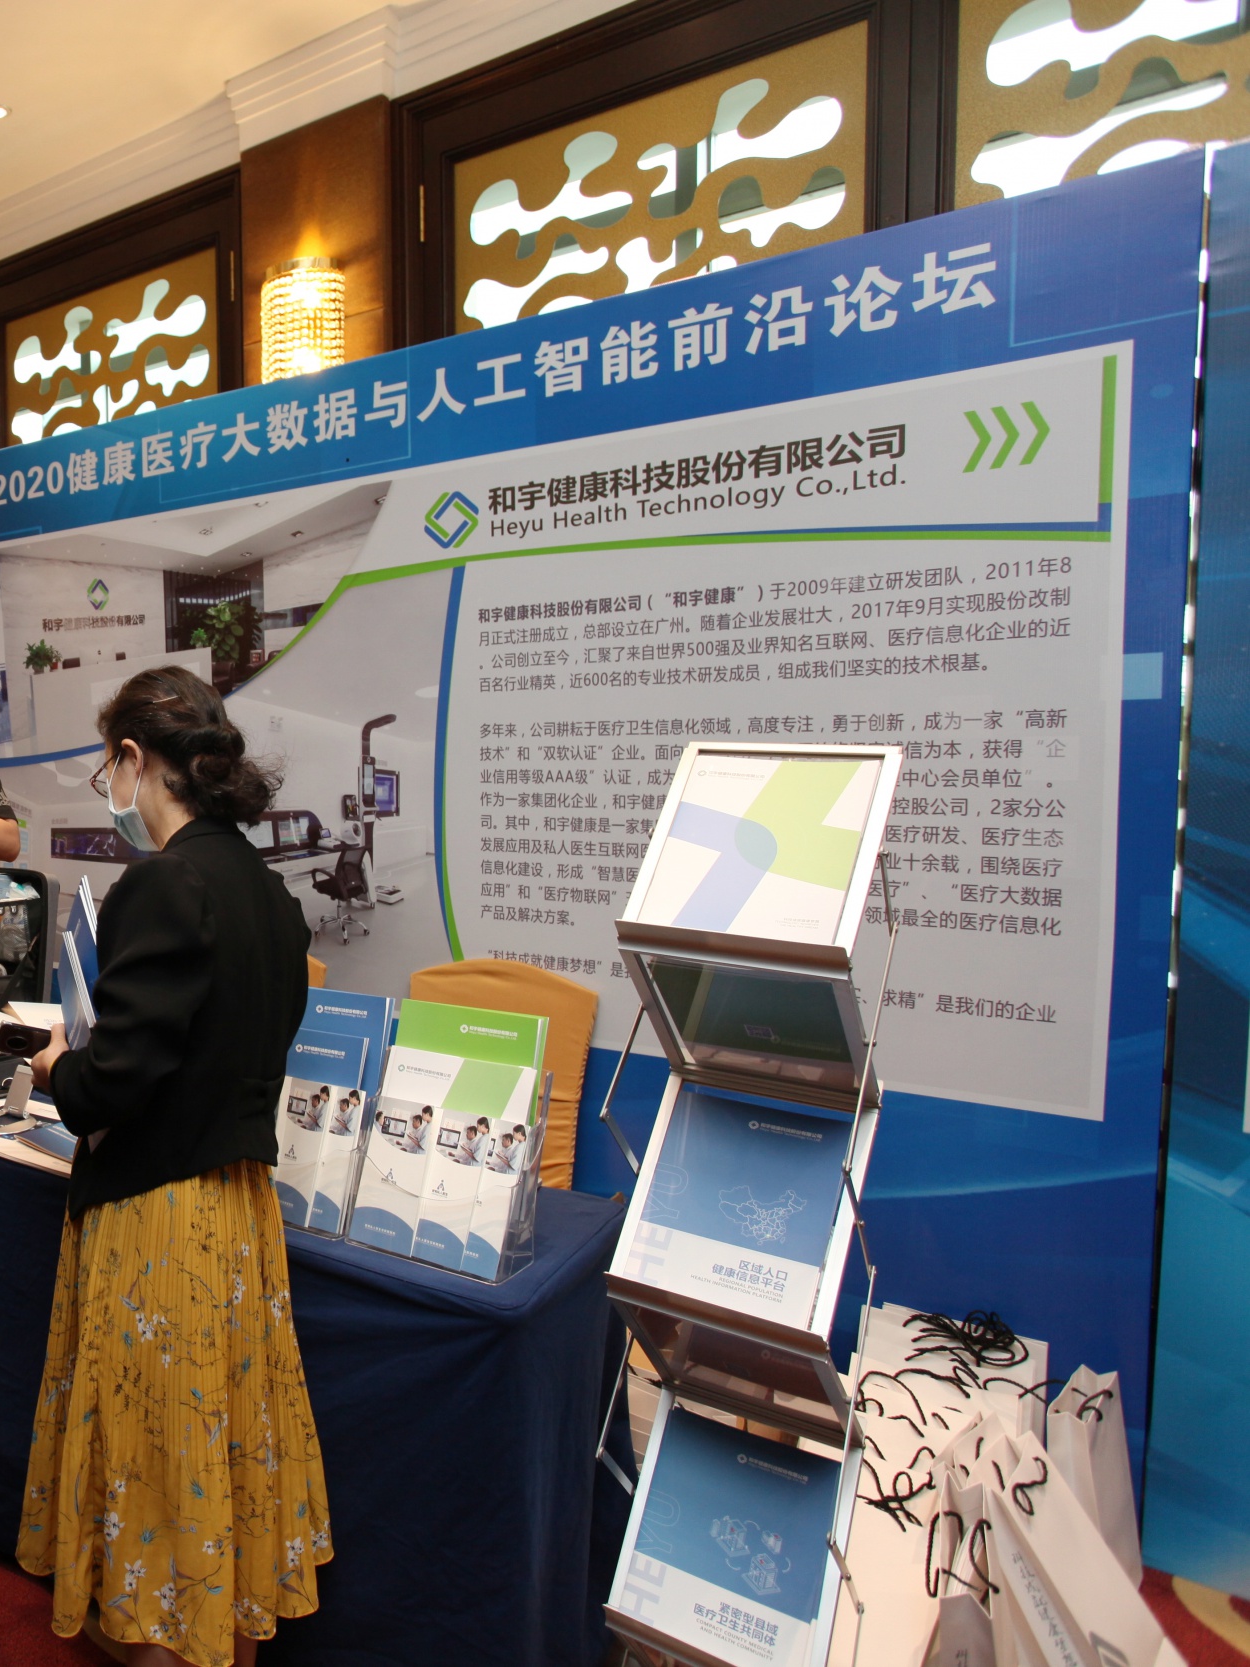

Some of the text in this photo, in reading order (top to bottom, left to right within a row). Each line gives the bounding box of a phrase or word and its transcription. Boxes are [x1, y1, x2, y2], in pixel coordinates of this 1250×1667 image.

[488, 424, 906, 515] 和宇健康科技股份有限公司
[491, 463, 906, 539] Heyu Health Technology Co.,Ltd.
[711, 1263, 786, 1293] 健康信息平台
[718, 1276, 784, 1298] REGIONAL POPULATION
[738, 1259, 789, 1282] 区域人口
[690, 1274, 783, 1304] HEALTH INFORMATION PLATFORM
[693, 1602, 776, 1647] 医疗卫生共同体
[695, 1618, 774, 1656] COMPACT COUNTY MEDICAL
[718, 1601, 779, 1637] 紧密型县域
[699, 1626, 774, 1662] AND HEALTH COMMUNITY
